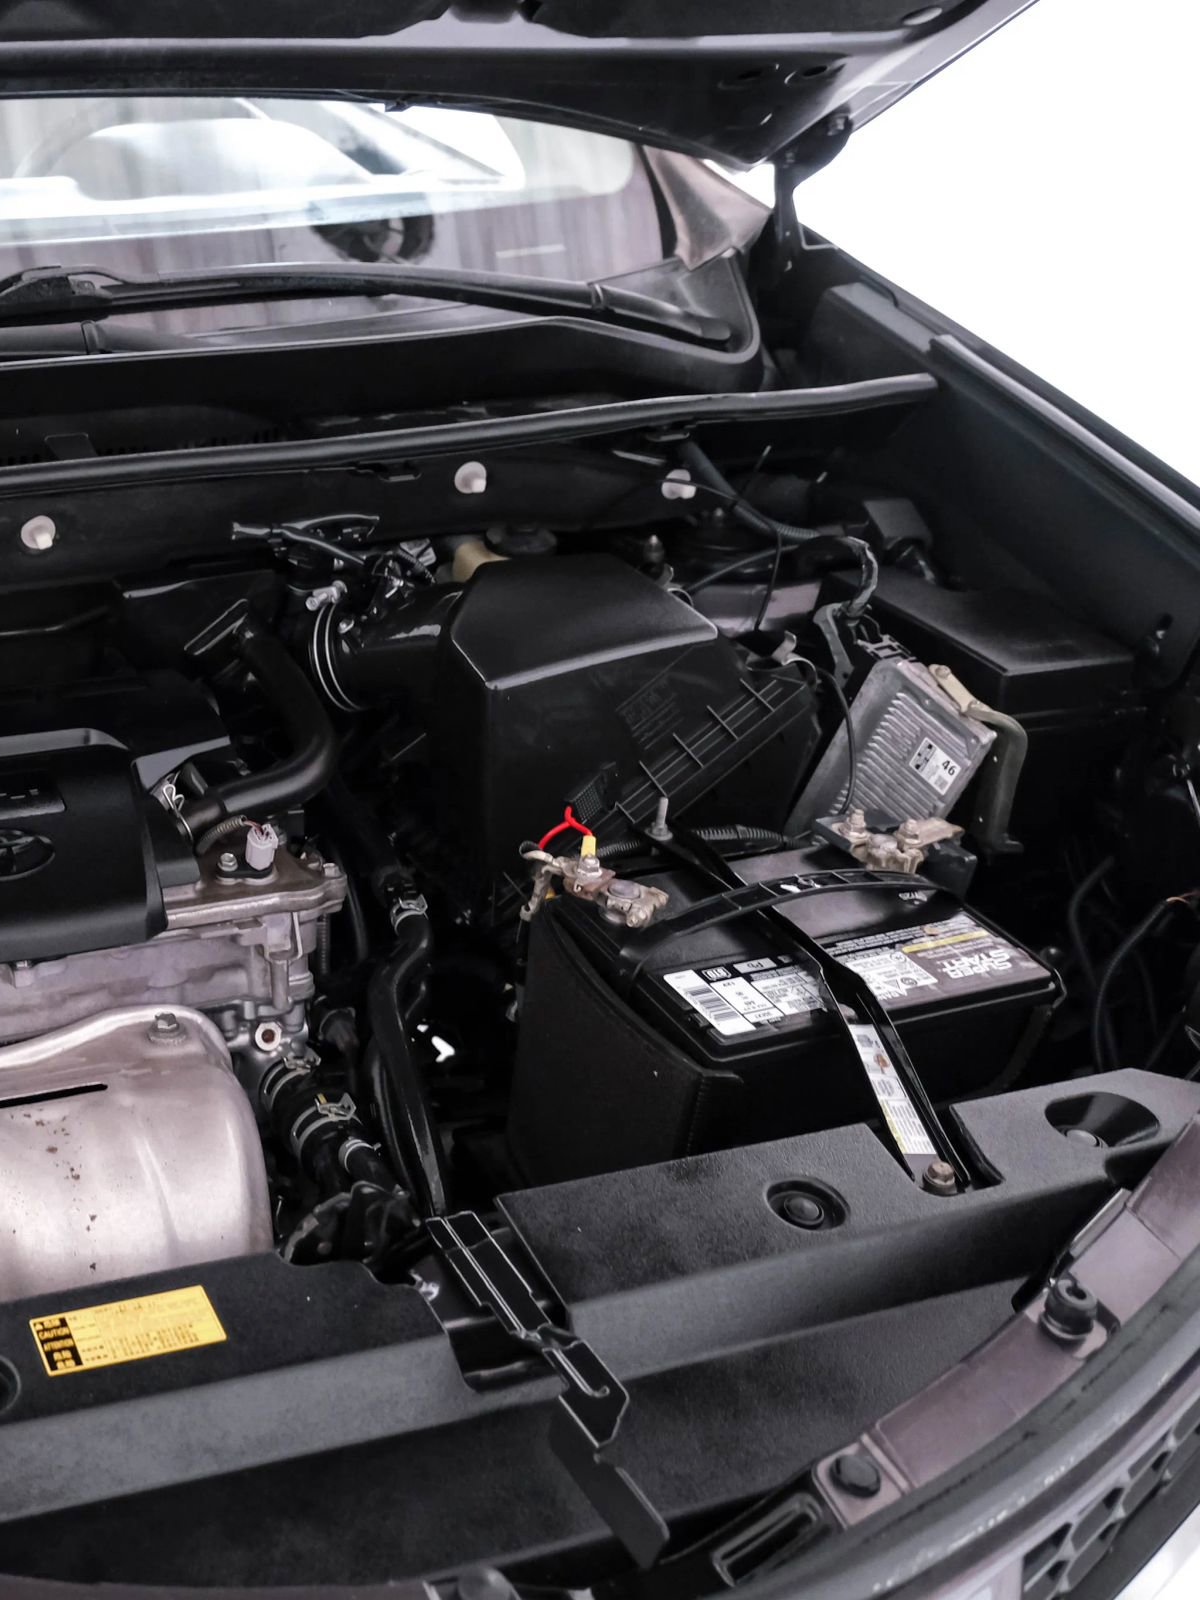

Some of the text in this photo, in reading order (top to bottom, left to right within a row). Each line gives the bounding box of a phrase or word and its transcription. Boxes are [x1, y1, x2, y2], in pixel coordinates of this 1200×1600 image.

[942, 760, 957, 776] 46
[942, 948, 1010, 972] START
[946, 960, 1012, 979] SUPER
[38, 1327, 70, 1340] CAUTION
